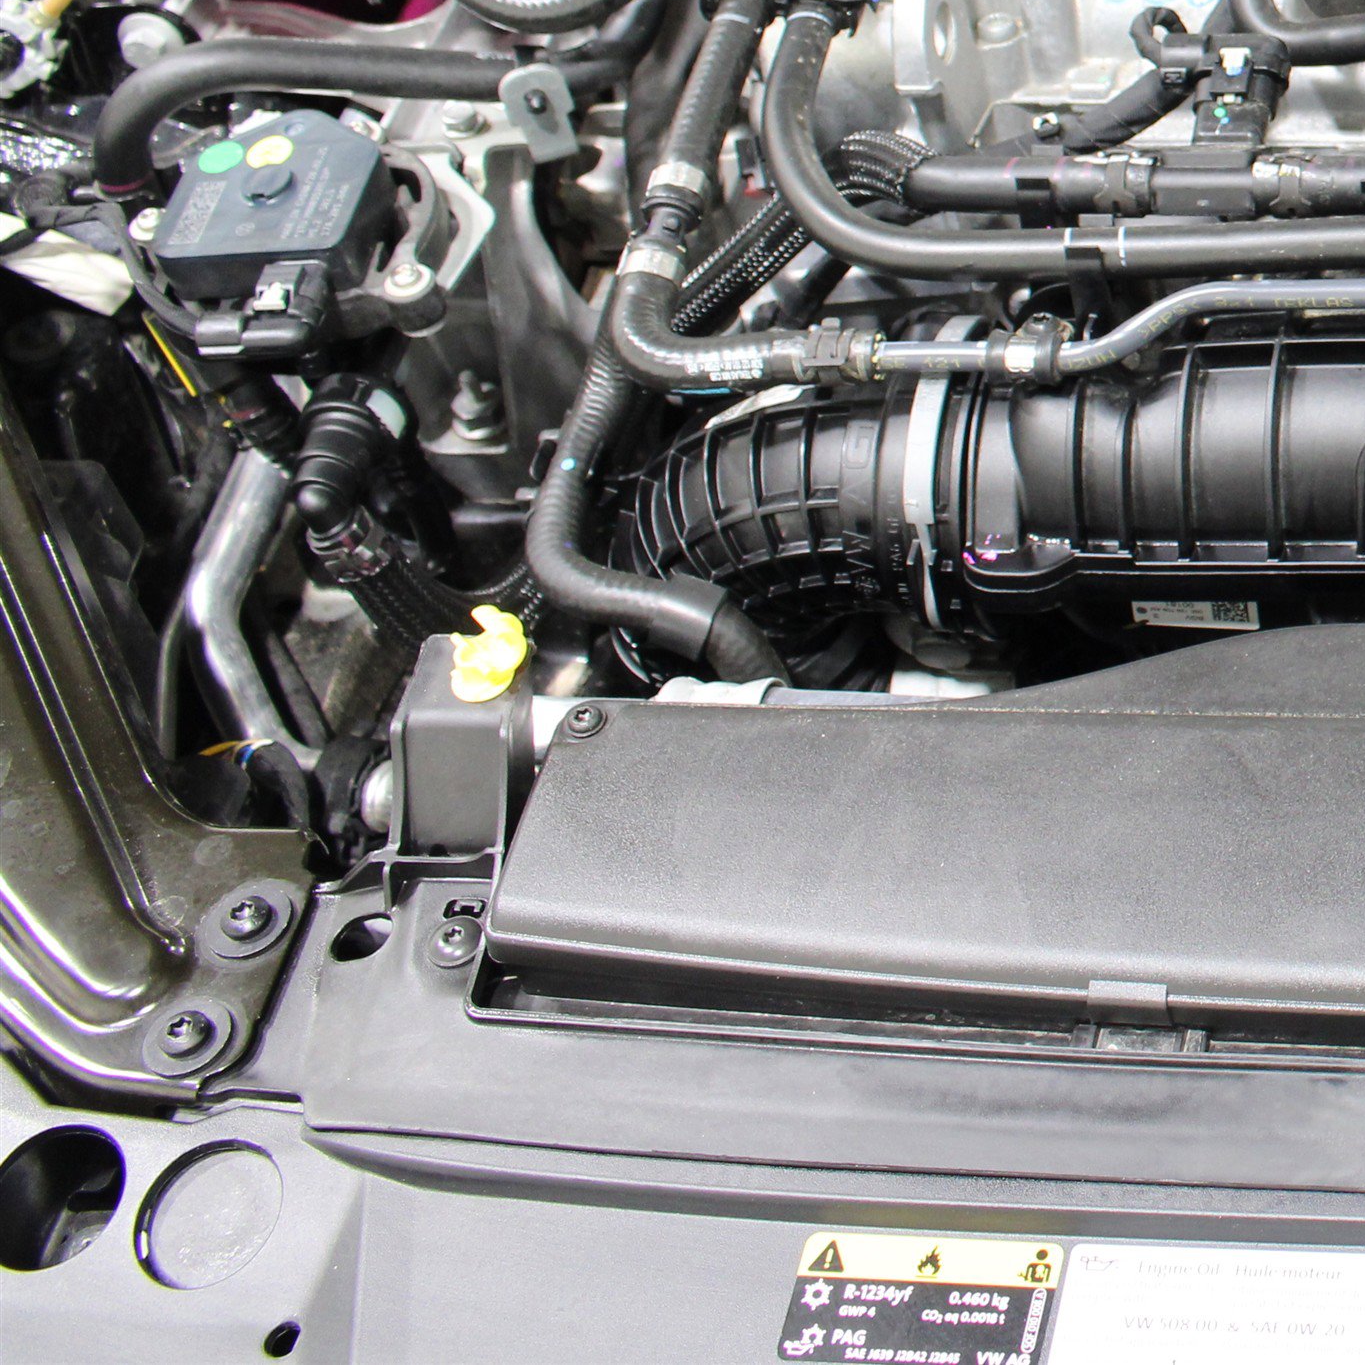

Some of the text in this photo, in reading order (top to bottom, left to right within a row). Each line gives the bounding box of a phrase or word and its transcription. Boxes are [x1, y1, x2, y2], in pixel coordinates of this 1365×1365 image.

[1273, 296, 1354, 308] TEKLAS
[843, 1283, 1010, 1311] R-1234yf 0.460 kg
[838, 1304, 866, 1318] GWP
[831, 1329, 867, 1346] PAG
[844, 1347, 866, 1360] SAE
[976, 1351, 1031, 1365] VW AG
